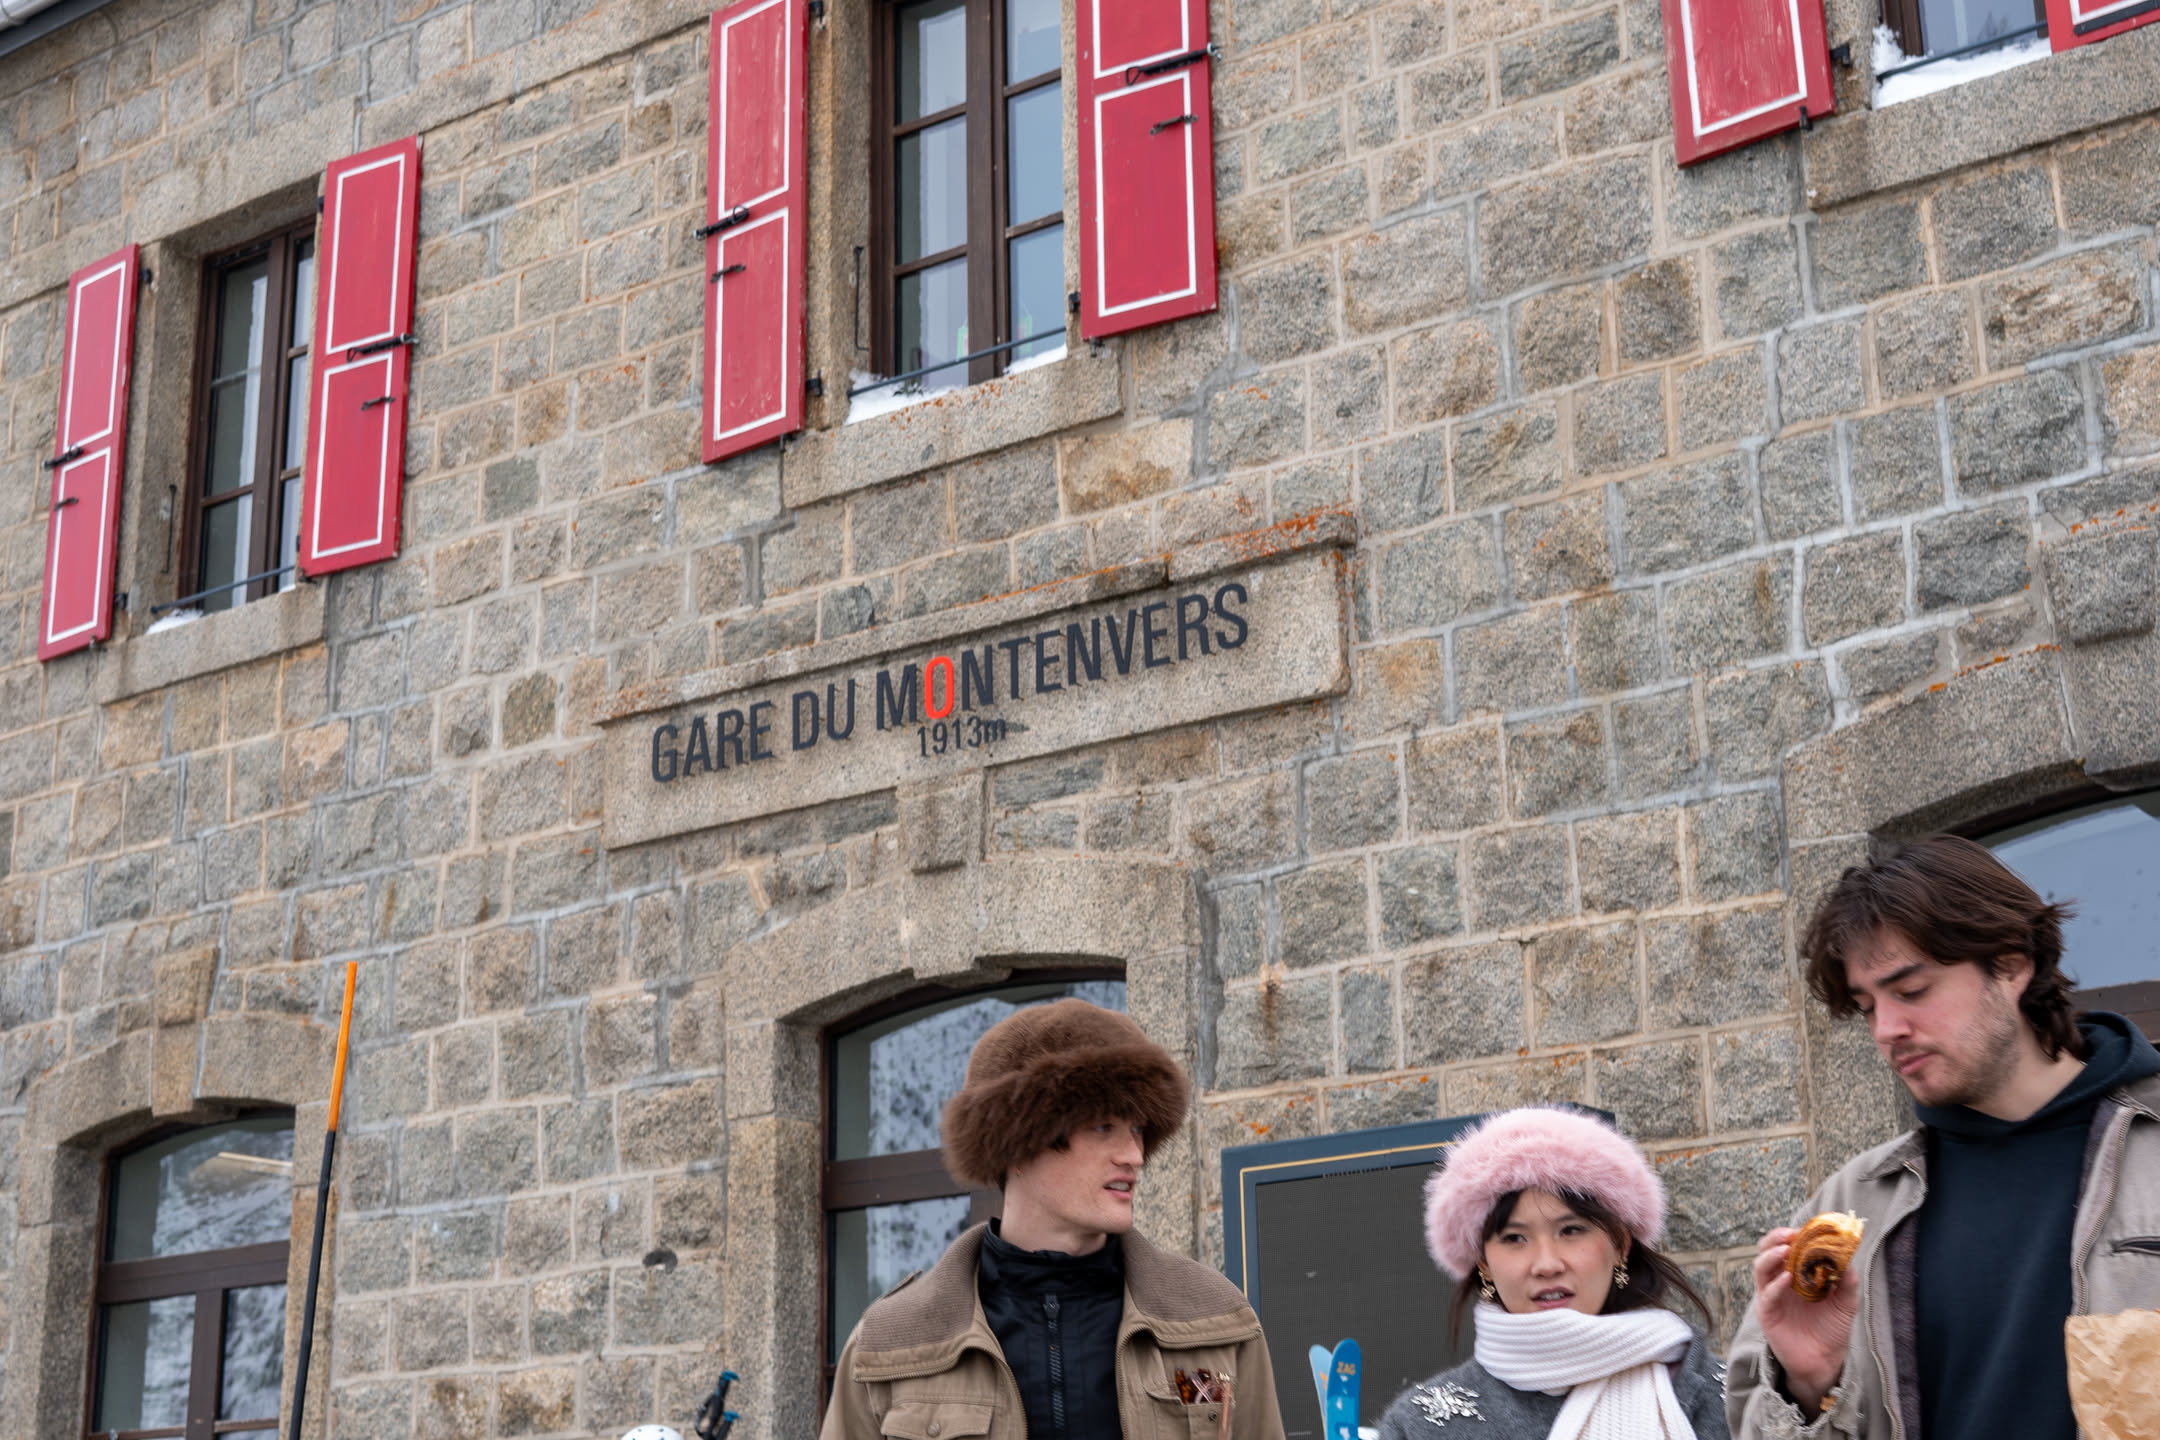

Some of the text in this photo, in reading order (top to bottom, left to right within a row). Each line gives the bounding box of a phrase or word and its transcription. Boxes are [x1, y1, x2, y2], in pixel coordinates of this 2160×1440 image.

[652, 584, 1248, 782] GARE DU MONTENVERS
